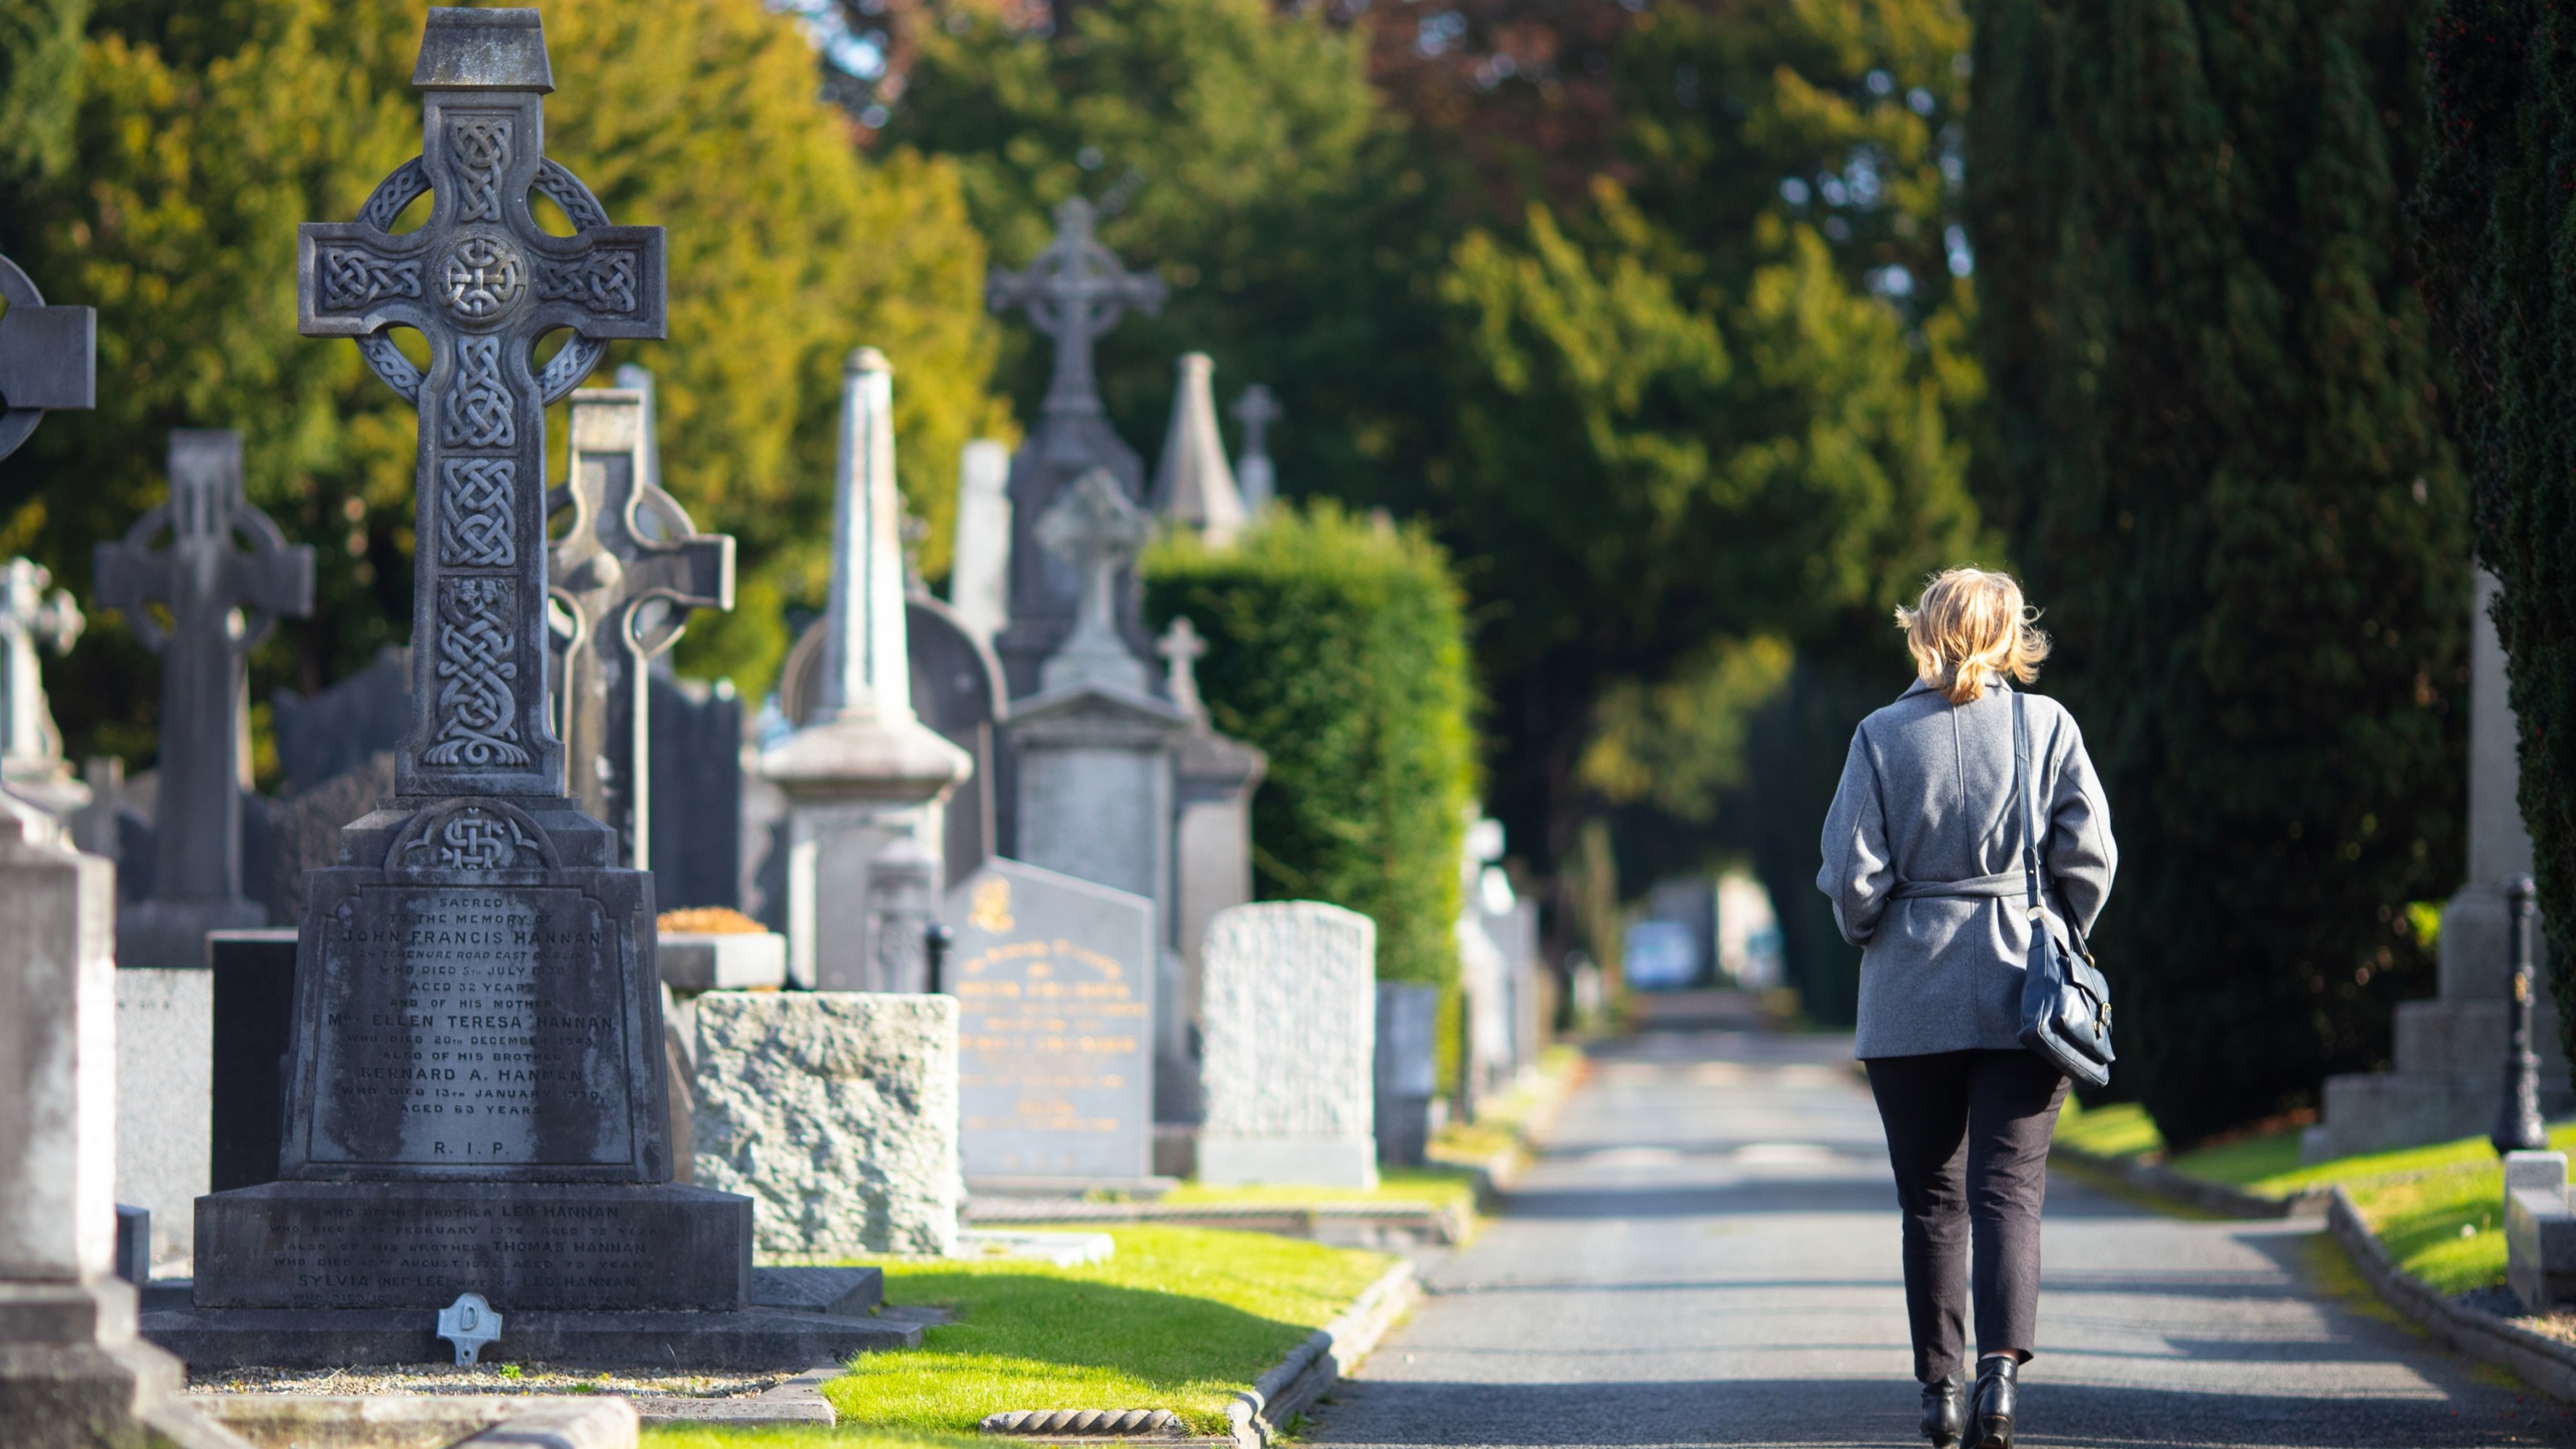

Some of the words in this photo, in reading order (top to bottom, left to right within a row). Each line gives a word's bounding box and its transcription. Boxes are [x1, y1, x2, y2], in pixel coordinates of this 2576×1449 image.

[440, 898, 503, 907] SACRED
[390, 914, 408, 923] TO
[418, 914, 447, 924] THE
[456, 914, 527, 924] MEMORY
[535, 914, 553, 924] OF
[343, 930, 400, 943] JOHN
[411, 930, 503, 943] FRANCIS
[382, 950, 452, 959] TERENURE
[456, 951, 490, 959] ROAD
[495, 951, 528, 960] EAST
[380, 965, 414, 974] WHO
[422, 966, 456, 974] DIED
[463, 966, 481, 975] 5TH
[488, 966, 525, 975] JULY
[410, 982, 451, 992] AGED
[459, 983, 476, 992] 32
[482, 983, 535, 992] YEARS
[390, 999, 418, 1008] AND
[430, 999, 446, 1008] OF
[373, 1014, 433, 1027] ELLEN
[447, 1016, 522, 1028] TERESA
[390, 1035, 423, 1044] DIED
[471, 1036, 546, 1045] DECEMBER
[383, 1051, 422, 1060] ALSO
[458, 1052, 483, 1061] HIS
[493, 1053, 561, 1061] BROTHER
[361, 1067, 456, 1080] BERNARD
[469, 1069, 488, 1080] A.
[498, 1069, 582, 1081] HANNAN
[389, 1087, 425, 1097] DIED
[435, 1088, 465, 1097] 13TH
[474, 1089, 551, 1098] JANUARY
[400, 1104, 443, 1114] AGED
[454, 1106, 474, 1114] 63
[391, 1208, 415, 1217] HIS
[425, 1209, 493, 1218] BROTHER
[501, 1206, 535, 1217] LEO
[543, 1206, 619, 1218] HANNAN
[396, 1226, 478, 1235] FEBRUARY
[288, 1243, 326, 1251] ALSO
[372, 1243, 398, 1252] HIS
[409, 1243, 481, 1253] BROTHER
[493, 1240, 564, 1253] THOMAS
[574, 1241, 647, 1253] HANNAN
[274, 1258, 306, 1266] WHO
[317, 1258, 352, 1266] DIED
[599, 1261, 654, 1269] YEARS
[298, 1274, 369, 1287] SYLVIA
[417, 1274, 450, 1287] LEE)
[523, 1276, 555, 1287] LEO
[564, 1277, 637, 1288] HANNAN
[461, 1303, 480, 1332] D
